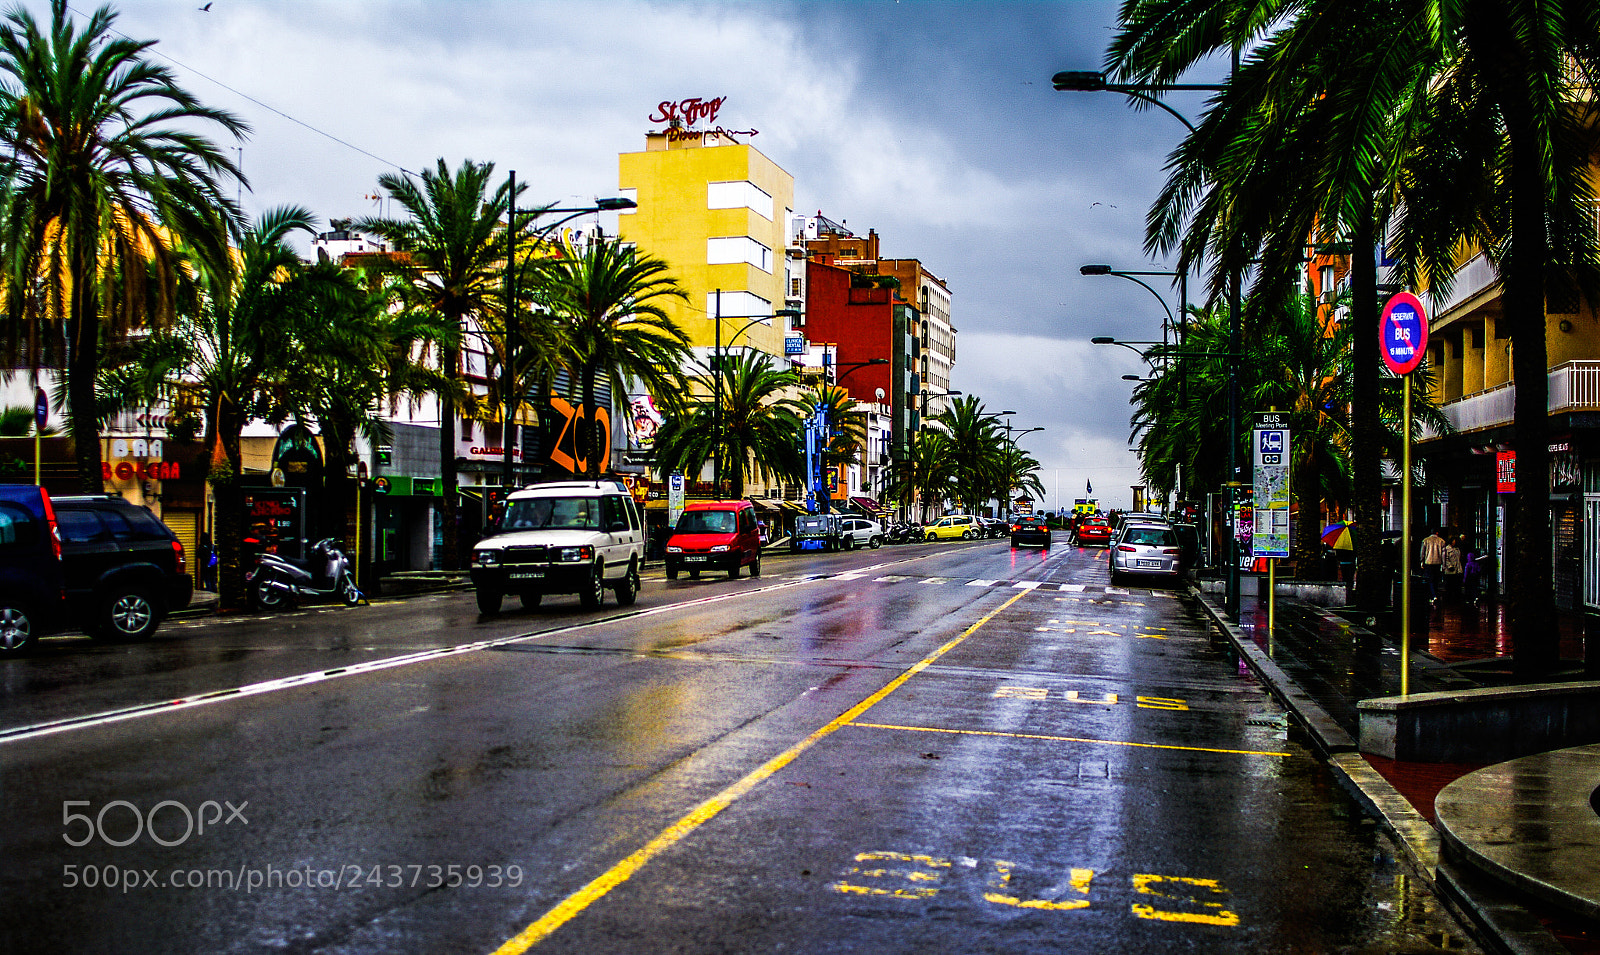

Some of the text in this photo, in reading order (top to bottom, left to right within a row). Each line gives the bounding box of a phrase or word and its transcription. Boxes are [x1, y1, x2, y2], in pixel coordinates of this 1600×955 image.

[663, 127, 700, 142] Disco
[1395, 328, 1411, 341] BUS
[1255, 422, 1275, 430] Meeting
[1263, 414, 1280, 423] BUS
[113, 439, 163, 457] BAR
[101, 461, 180, 481] BOLERA
[993, 685, 1190, 712] BUS
[832, 851, 1240, 927] BUS
